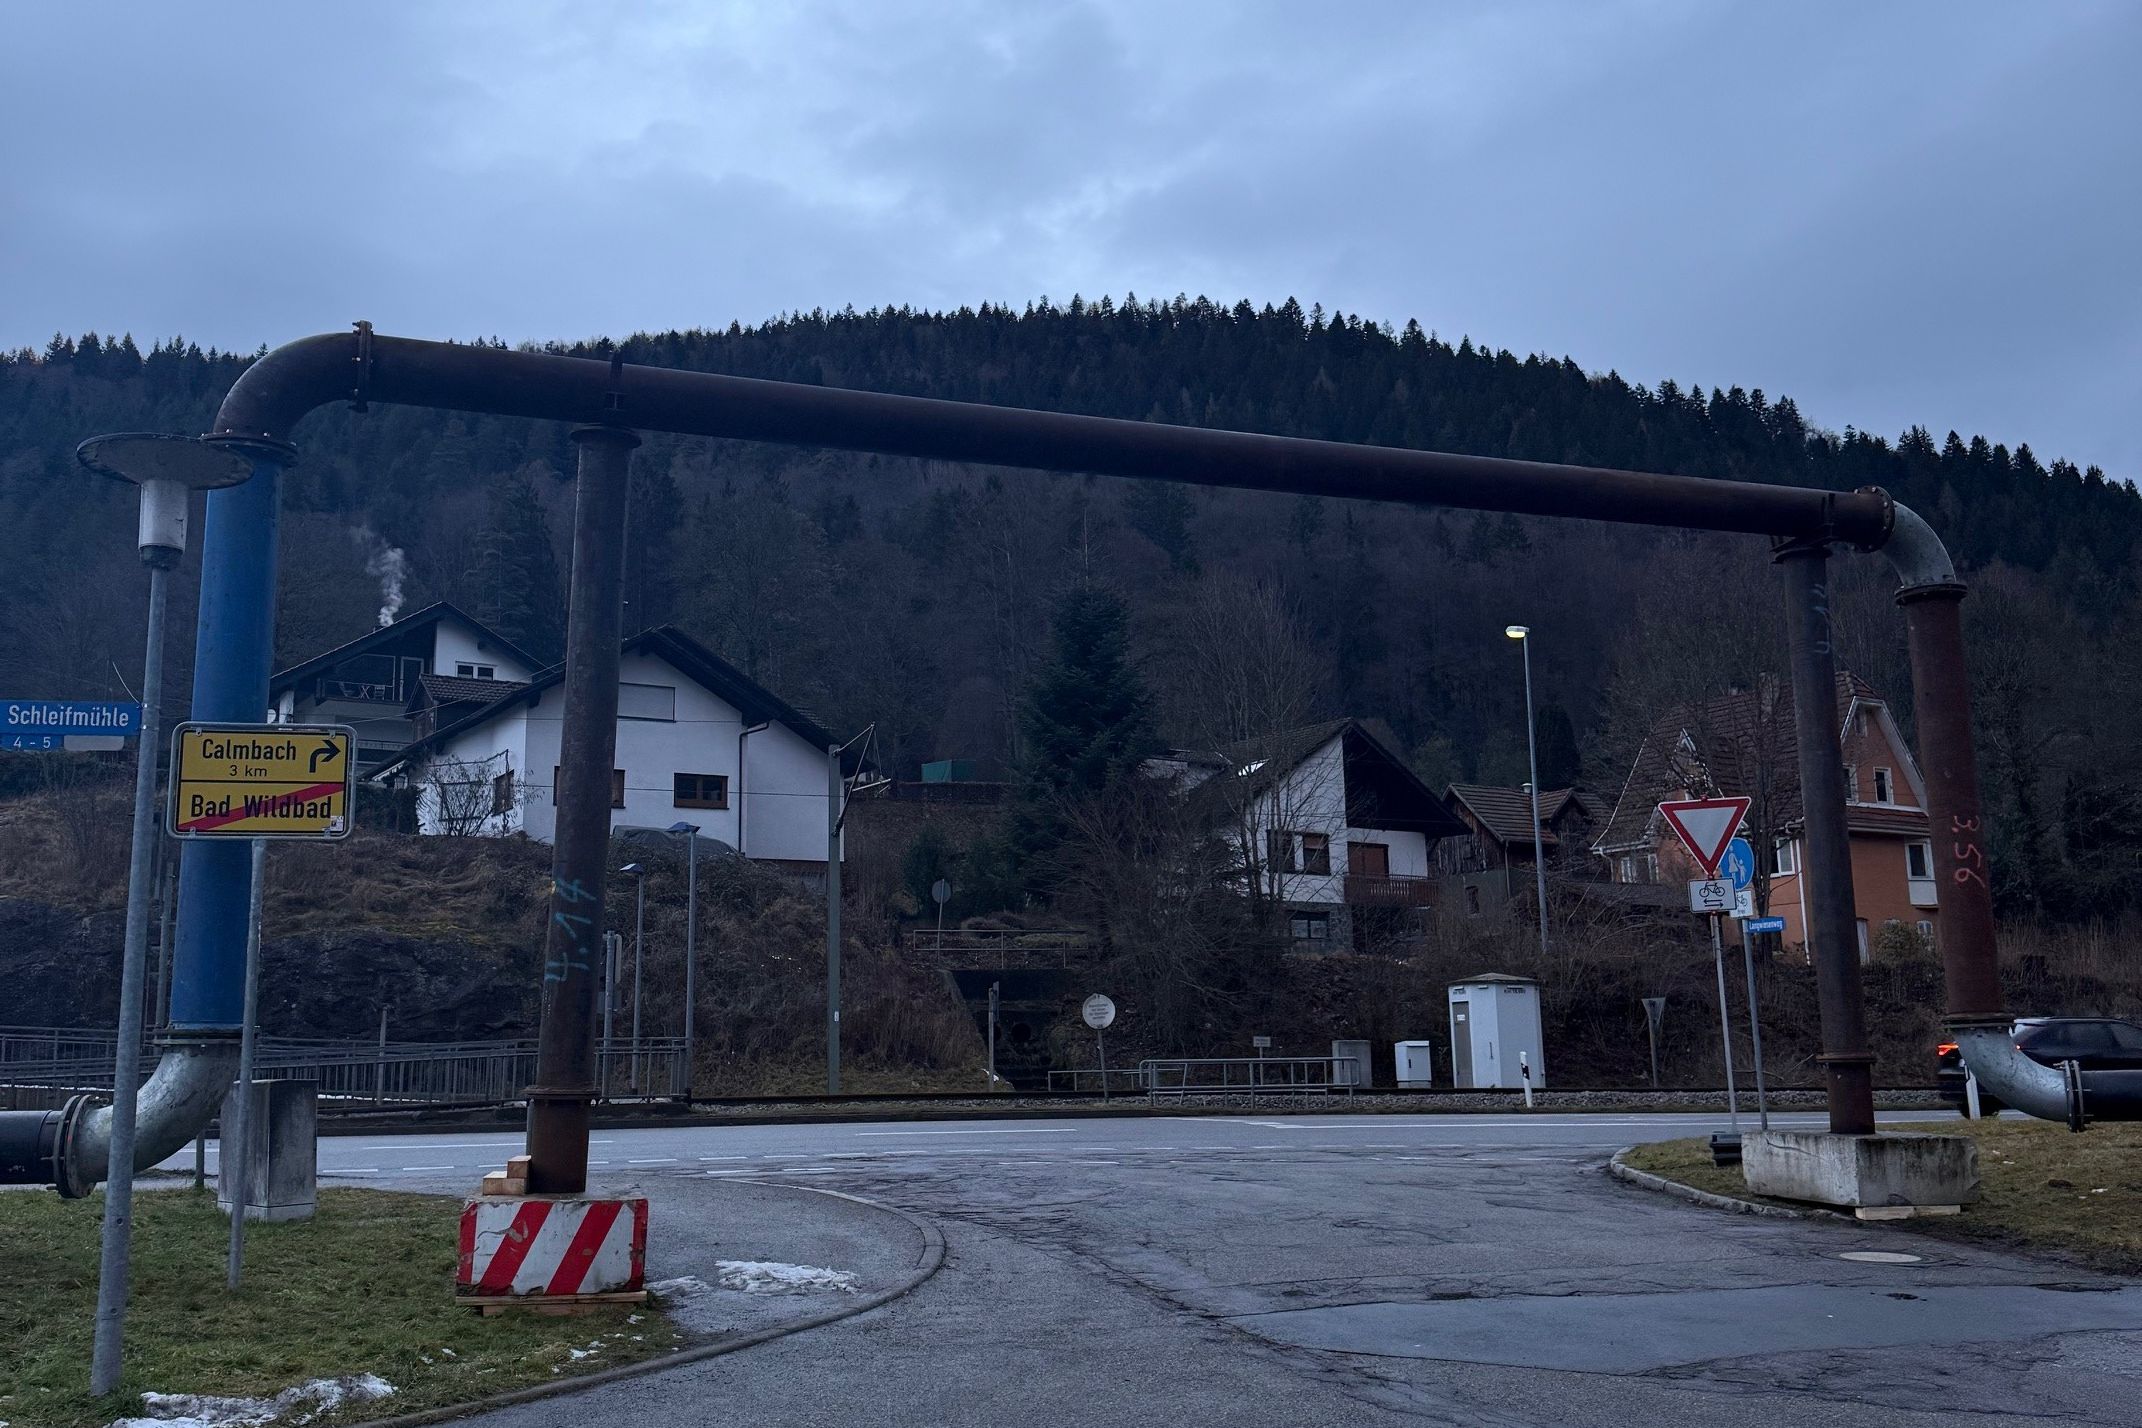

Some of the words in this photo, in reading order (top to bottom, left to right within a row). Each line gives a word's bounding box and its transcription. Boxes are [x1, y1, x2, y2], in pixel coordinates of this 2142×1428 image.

[8, 704, 129, 727] Schleifmühle
[13, 735, 21, 749] 4
[43, 736, 51, 749] 5
[202, 738, 297, 760] Calmbach
[229, 764, 238, 777] 3
[245, 764, 267, 777] km
[191, 794, 231, 818] Bad
[243, 794, 332, 818] Wildbad
